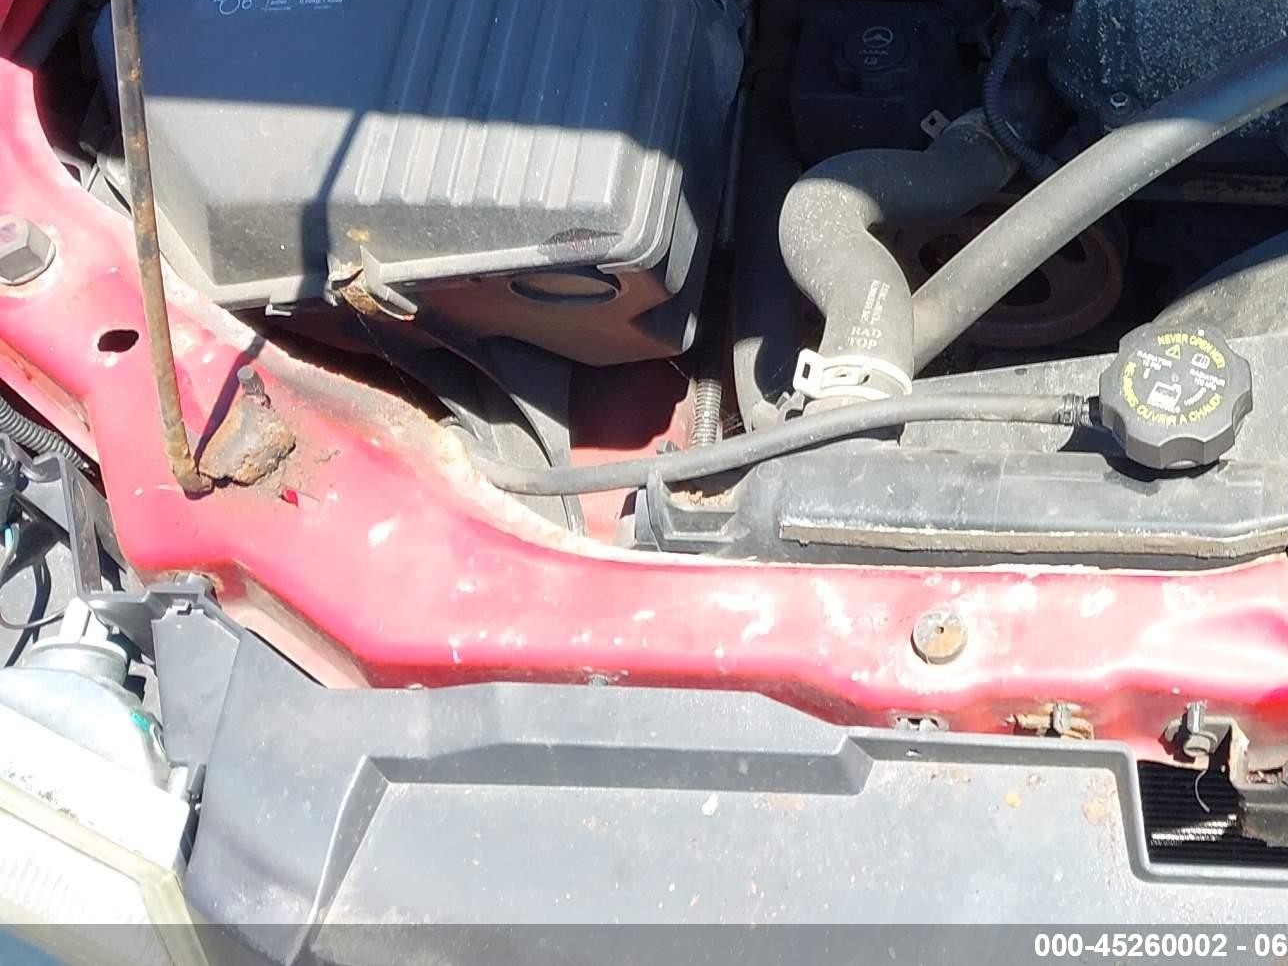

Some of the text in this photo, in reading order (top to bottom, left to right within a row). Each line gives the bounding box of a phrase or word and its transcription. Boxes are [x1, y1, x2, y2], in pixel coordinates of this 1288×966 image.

[852, 326, 882, 339] RAD
[847, 337, 878, 350] TOP
[1157, 333, 1189, 346] NEVER
[1189, 335, 1213, 353] OPEN
[1136, 404, 1177, 425] OUVRIR
[1188, 393, 1223, 422] CHAUD
